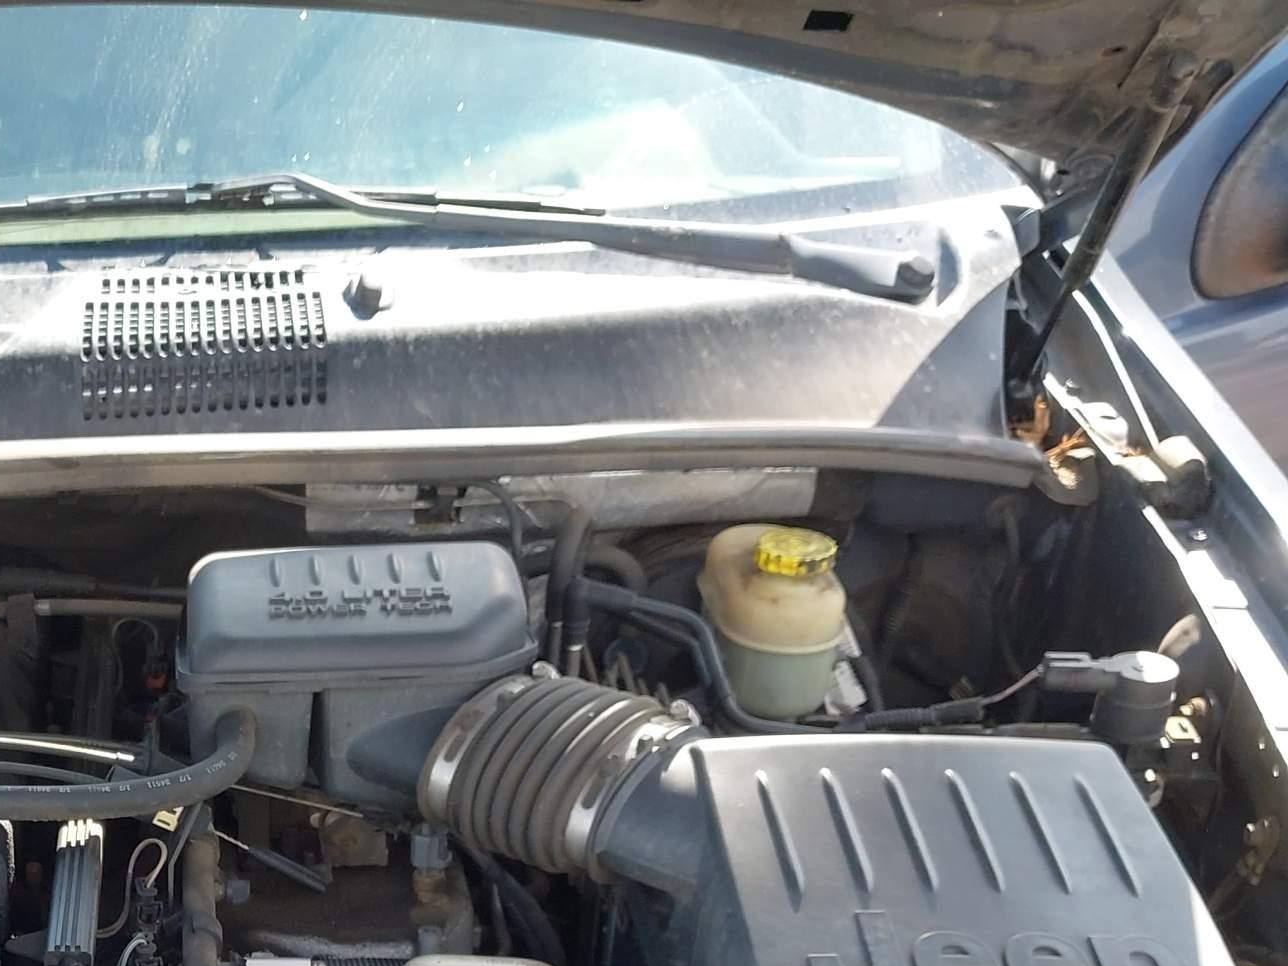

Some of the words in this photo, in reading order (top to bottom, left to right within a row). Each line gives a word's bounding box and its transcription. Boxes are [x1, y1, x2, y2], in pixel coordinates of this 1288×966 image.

[269, 588, 328, 605] 4.0
[341, 586, 451, 604] LITER
[268, 603, 367, 620] POWER
[379, 600, 454, 617] TECH
